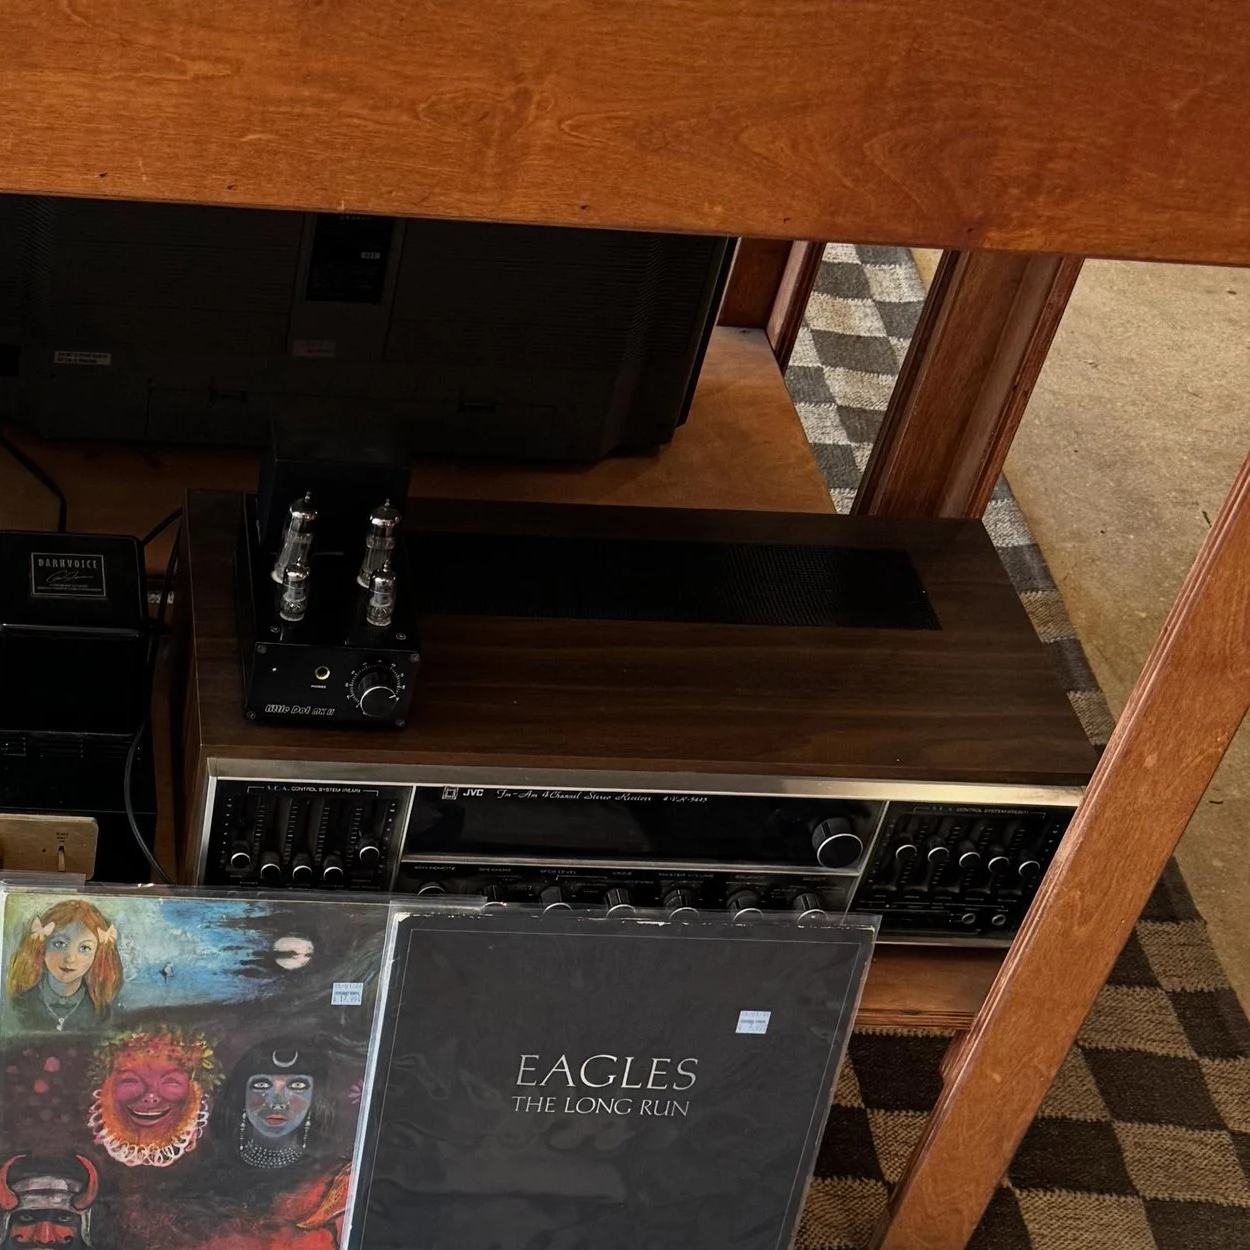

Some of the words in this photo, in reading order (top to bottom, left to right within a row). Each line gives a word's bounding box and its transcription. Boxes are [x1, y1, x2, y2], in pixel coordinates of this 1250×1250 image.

[37, 558, 98, 569] DARKVOICE
[515, 1053, 698, 1091] EAGLES
[511, 1095, 556, 1113] THE
[564, 1096, 632, 1116] LONG
[639, 1098, 690, 1117] RUN
